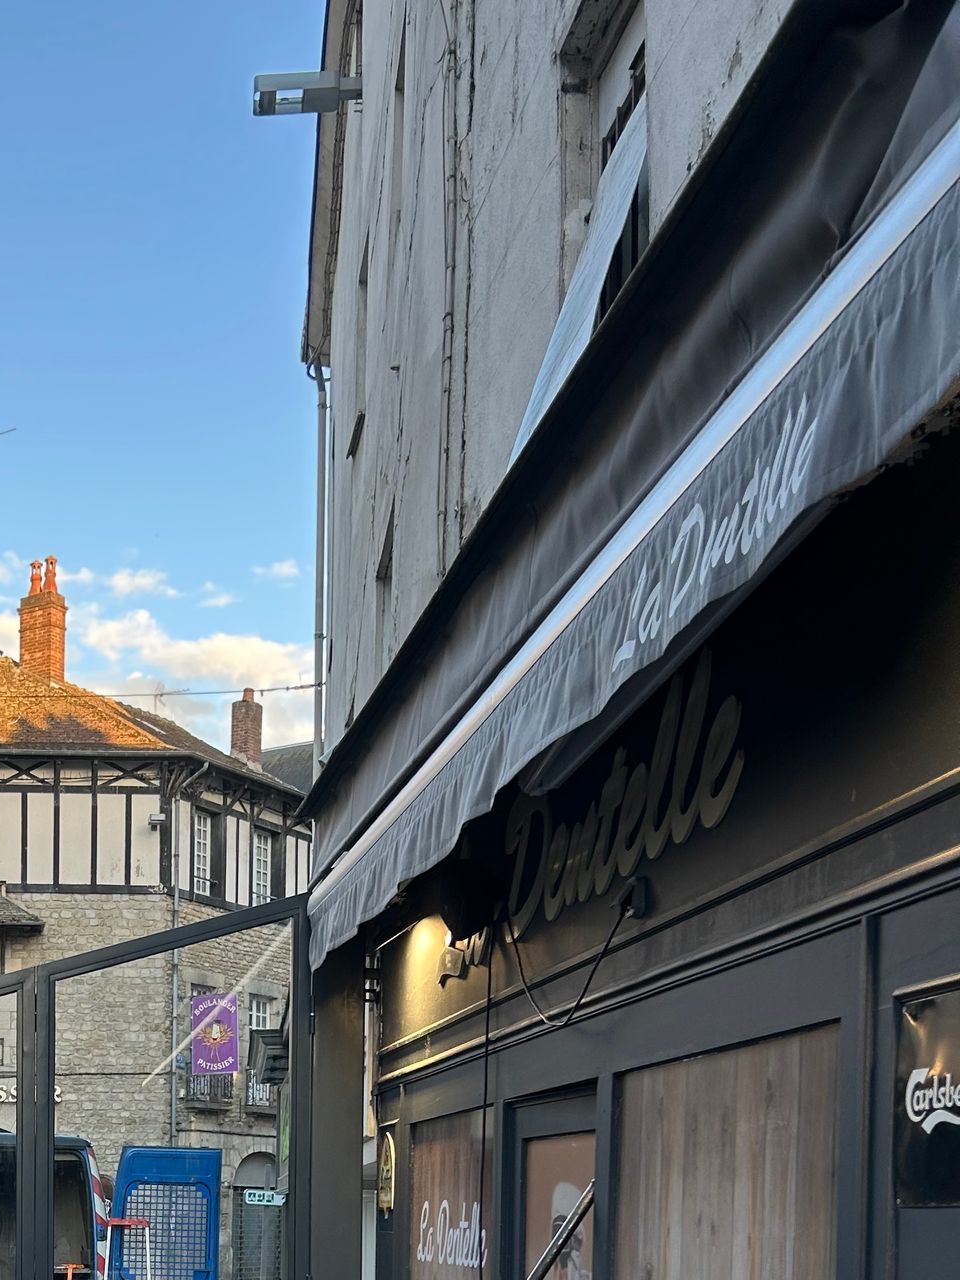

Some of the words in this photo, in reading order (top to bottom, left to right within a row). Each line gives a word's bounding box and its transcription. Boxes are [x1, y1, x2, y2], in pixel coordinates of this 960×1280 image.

[612, 560, 662, 672] La
[504, 644, 744, 943] Dentelle
[193, 998, 236, 1016] BOULANGER
[197, 1055, 235, 1071] PATISSIER
[416, 1200, 435, 1264] La
